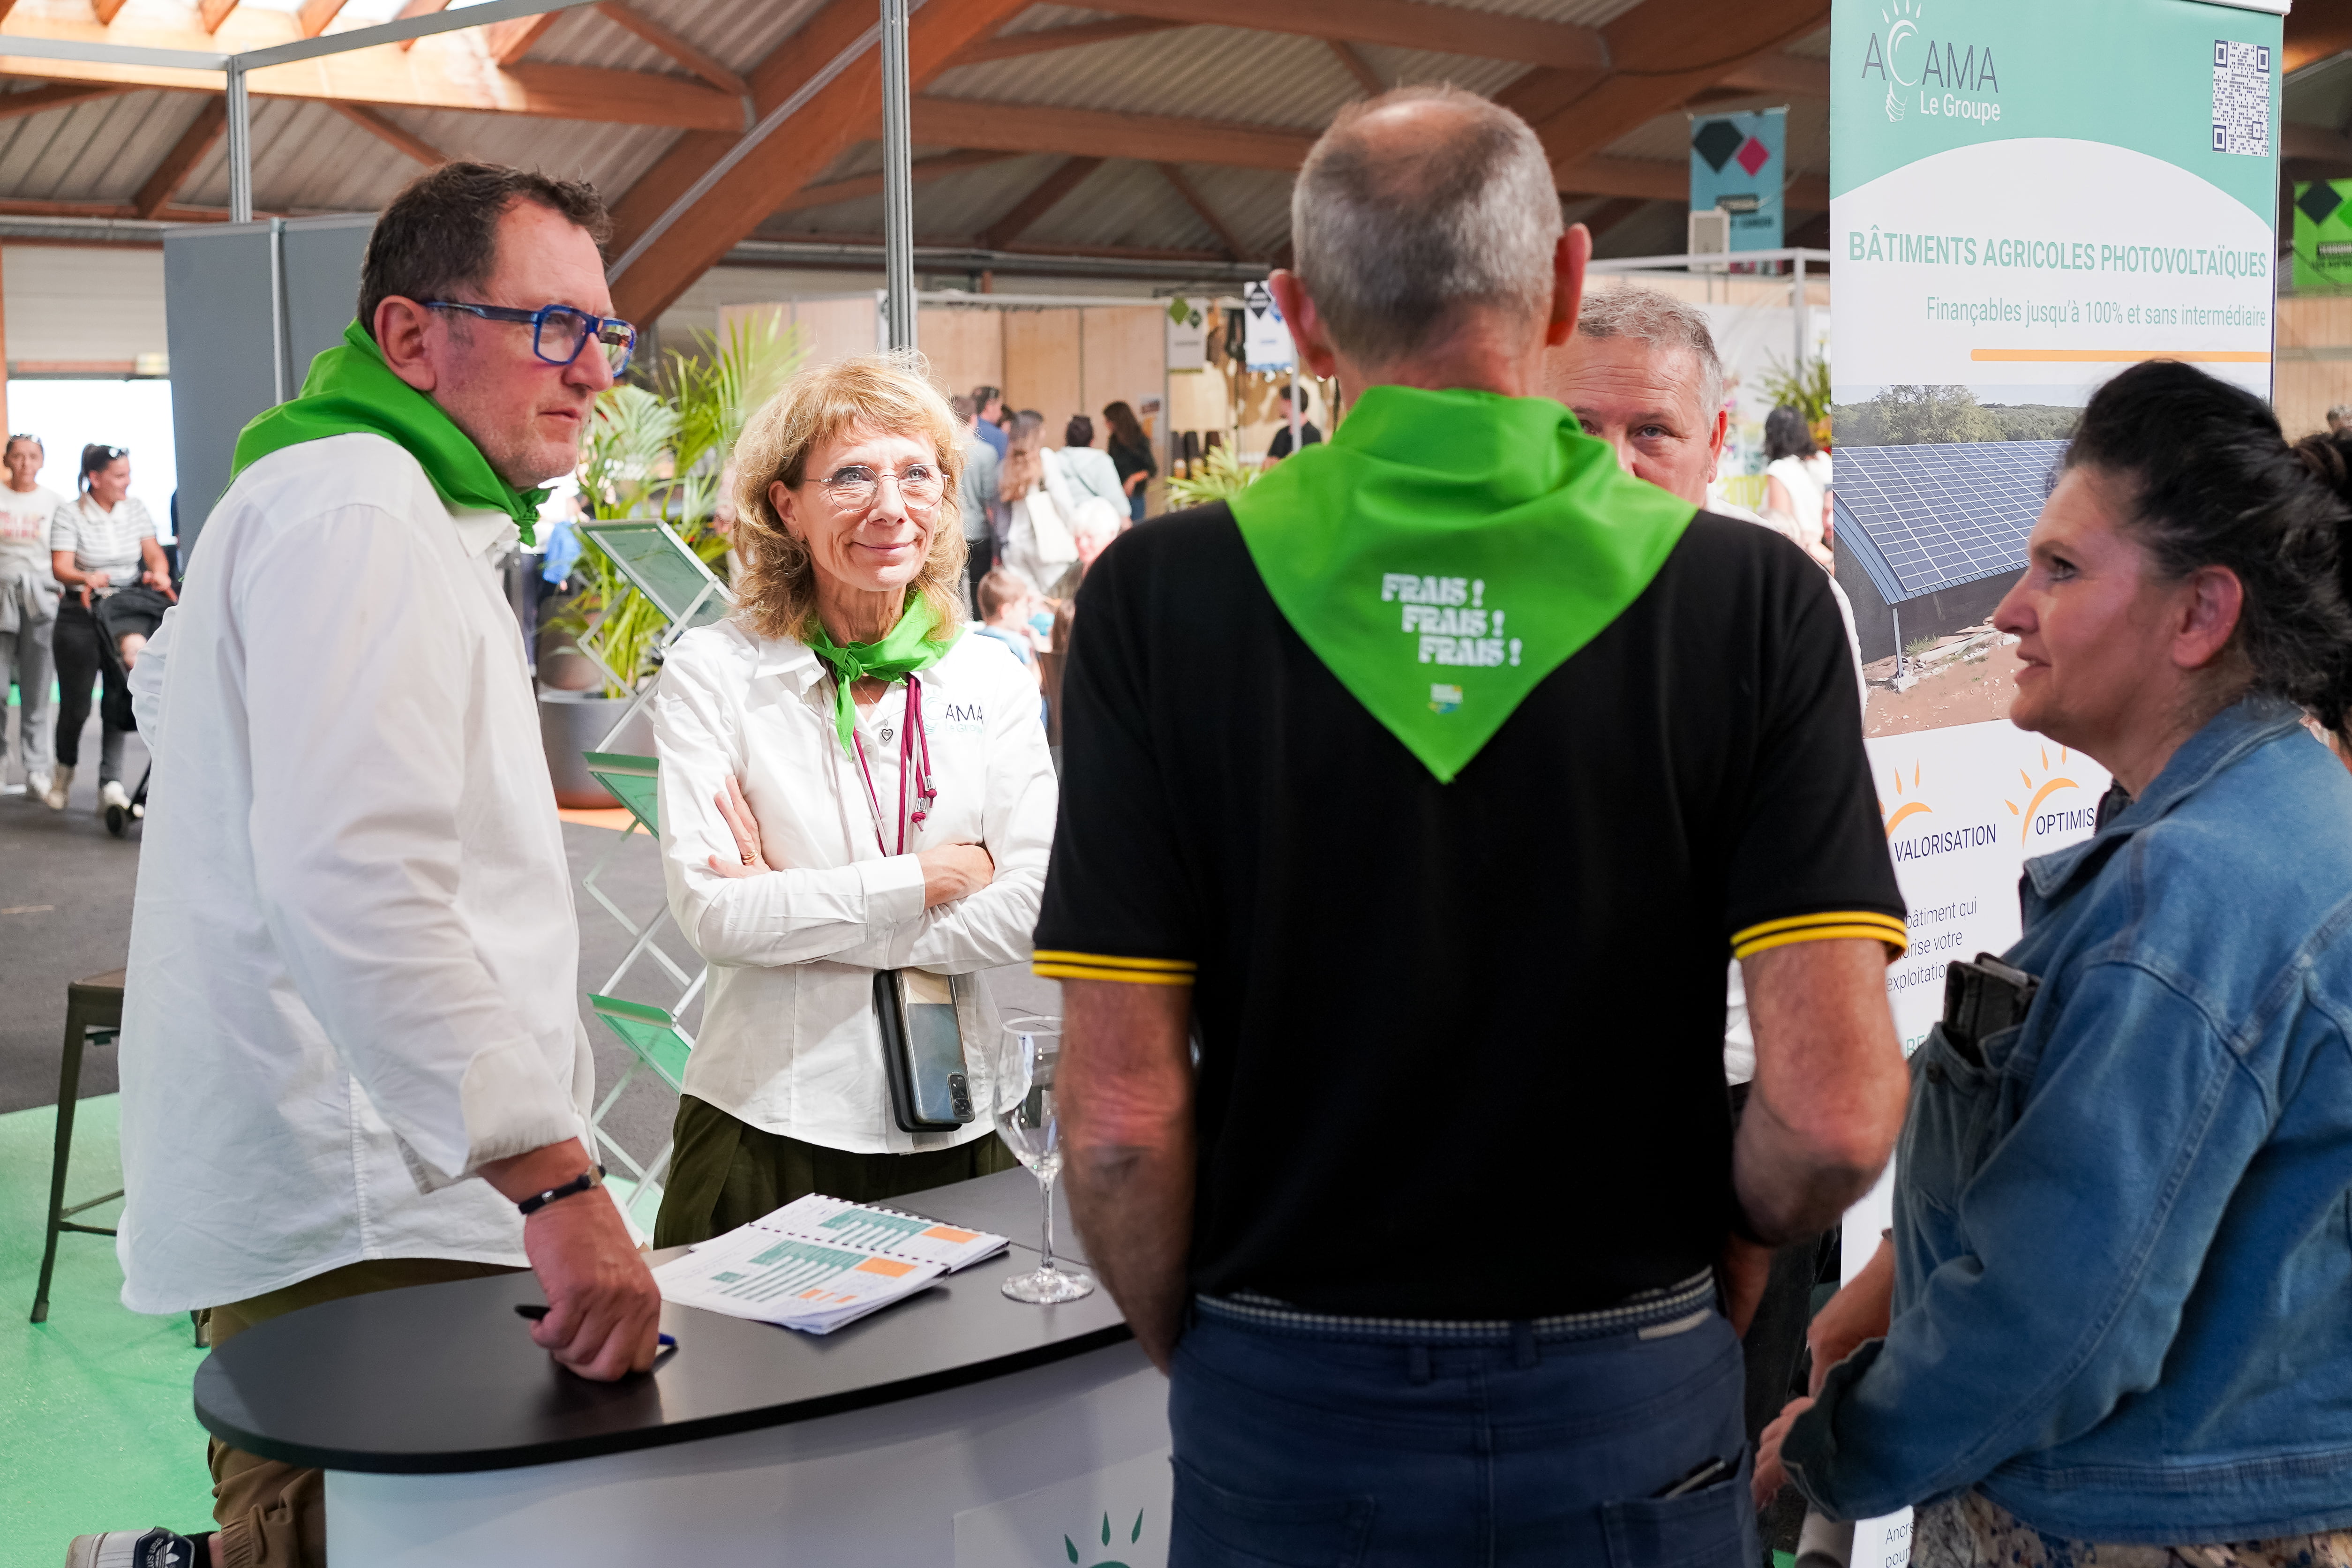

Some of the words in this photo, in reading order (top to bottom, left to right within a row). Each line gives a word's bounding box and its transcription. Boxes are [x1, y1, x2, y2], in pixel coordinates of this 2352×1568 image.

[1862, 19, 1999, 93] ACAMA
[1920, 90, 1939, 115] Le
[1943, 93, 2001, 126] Groupe
[1849, 224, 1977, 266] BÂTIMENTS
[1983, 238, 2095, 271] AGRICOLES
[2101, 244, 2266, 279] PHOTOVOLTAÏQUES
[1927, 296, 2021, 327] Finançables
[2025, 300, 2080, 328] jusqu'à
[2085, 301, 2123, 323] 100%
[2127, 304, 2141, 324] et
[2145, 307, 2177, 325] sans
[2181, 303, 2266, 326] intermédiaire
[1381, 572, 1468, 607] FRAIS
[1402, 603, 1488, 638] FRAIS
[1418, 635, 1505, 667] FRAIS
[2036, 807, 2095, 835] OPTIMIS
[1894, 823, 1996, 862] VALORISATION
[1960, 896, 1977, 920] qui
[1900, 938, 1931, 960] orise
[1933, 931, 1963, 951] votre
[1886, 961, 1948, 994] exploitatio
[1886, 1522, 1914, 1545] Ancre
